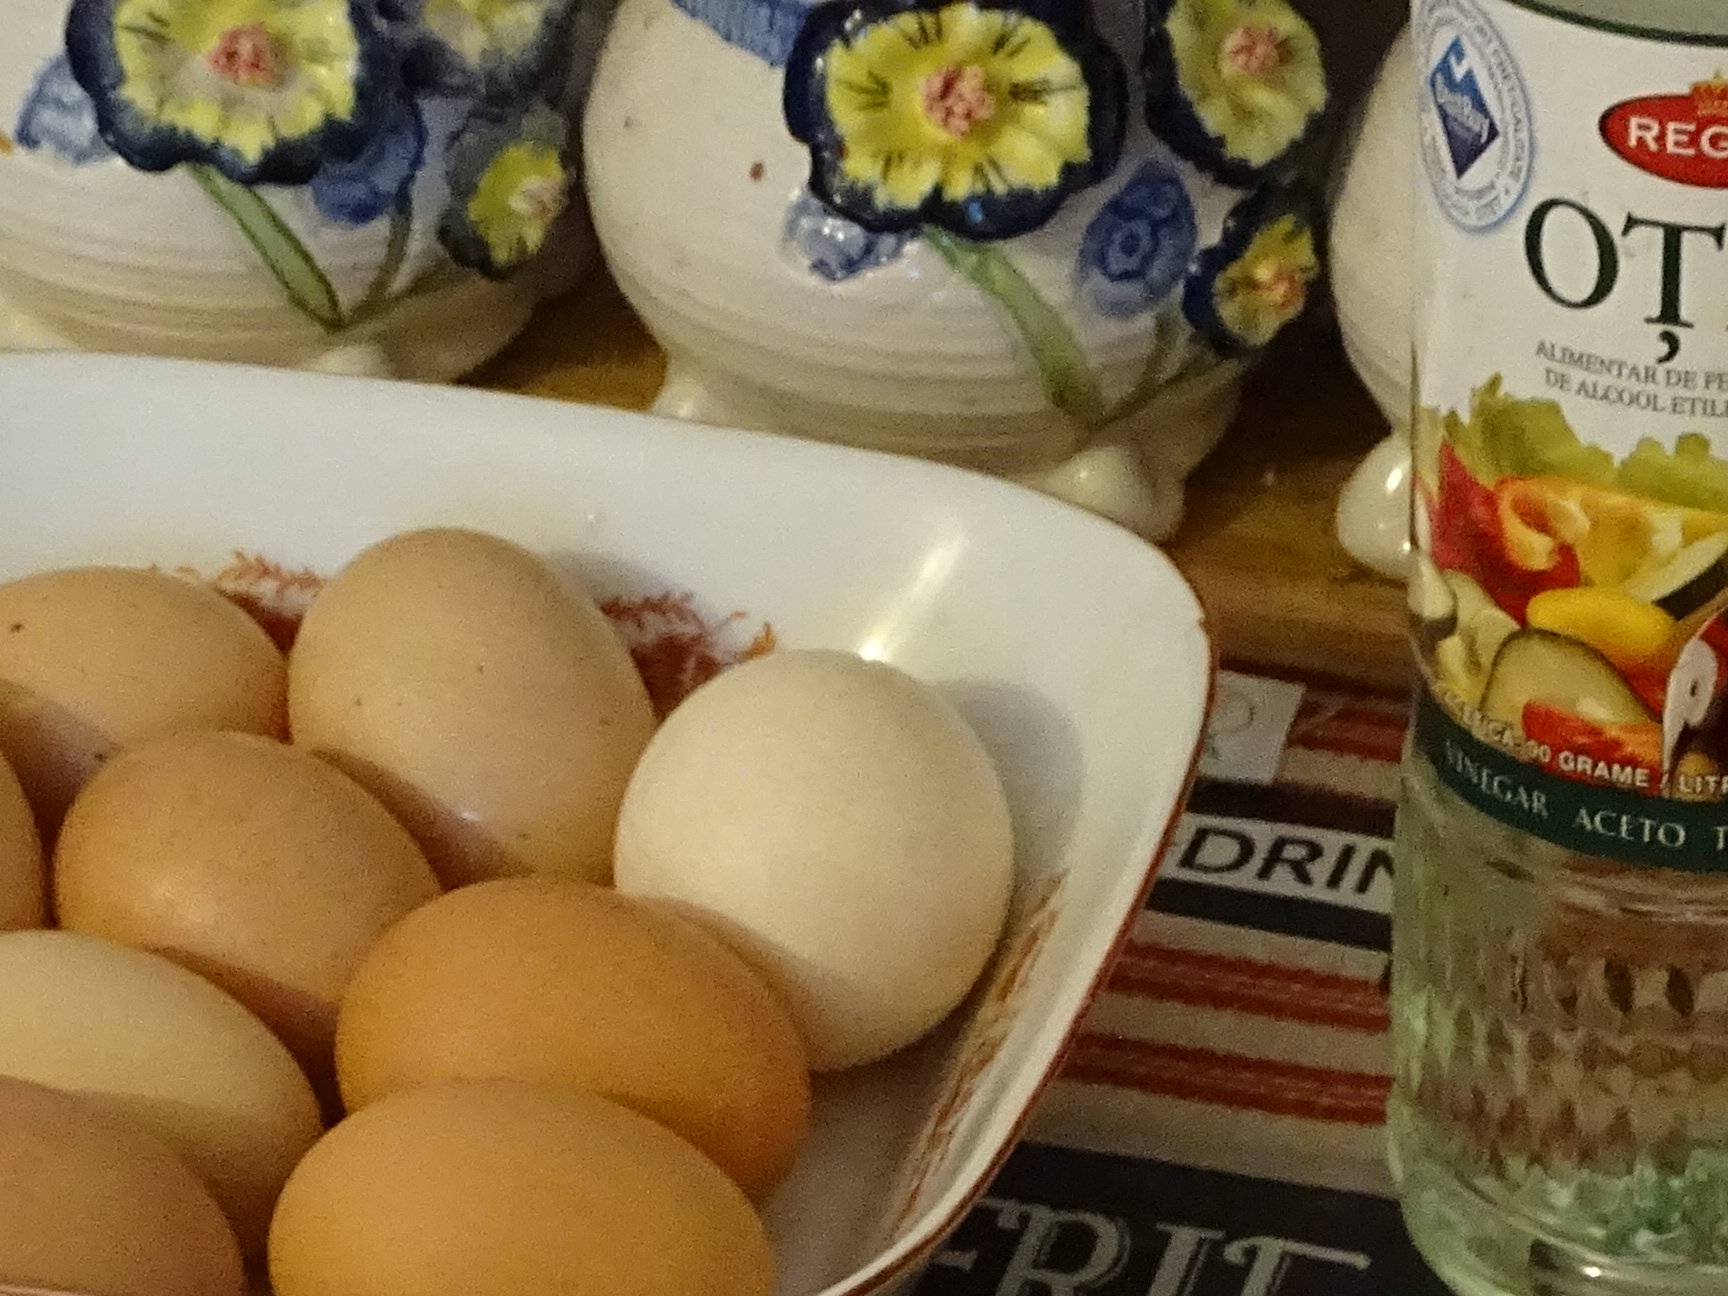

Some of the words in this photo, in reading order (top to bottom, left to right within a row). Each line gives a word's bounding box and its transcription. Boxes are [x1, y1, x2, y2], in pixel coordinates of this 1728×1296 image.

[1535, 339, 1659, 386] ALIMENTAR
[1666, 369, 1700, 390] DE
[1544, 367, 1572, 392] DE
[1575, 378, 1666, 414] ALCOOL
[1445, 738, 1550, 820] VINEGAR
[1573, 806, 1688, 849] ACETO
[1558, 750, 1651, 788] GRAME
